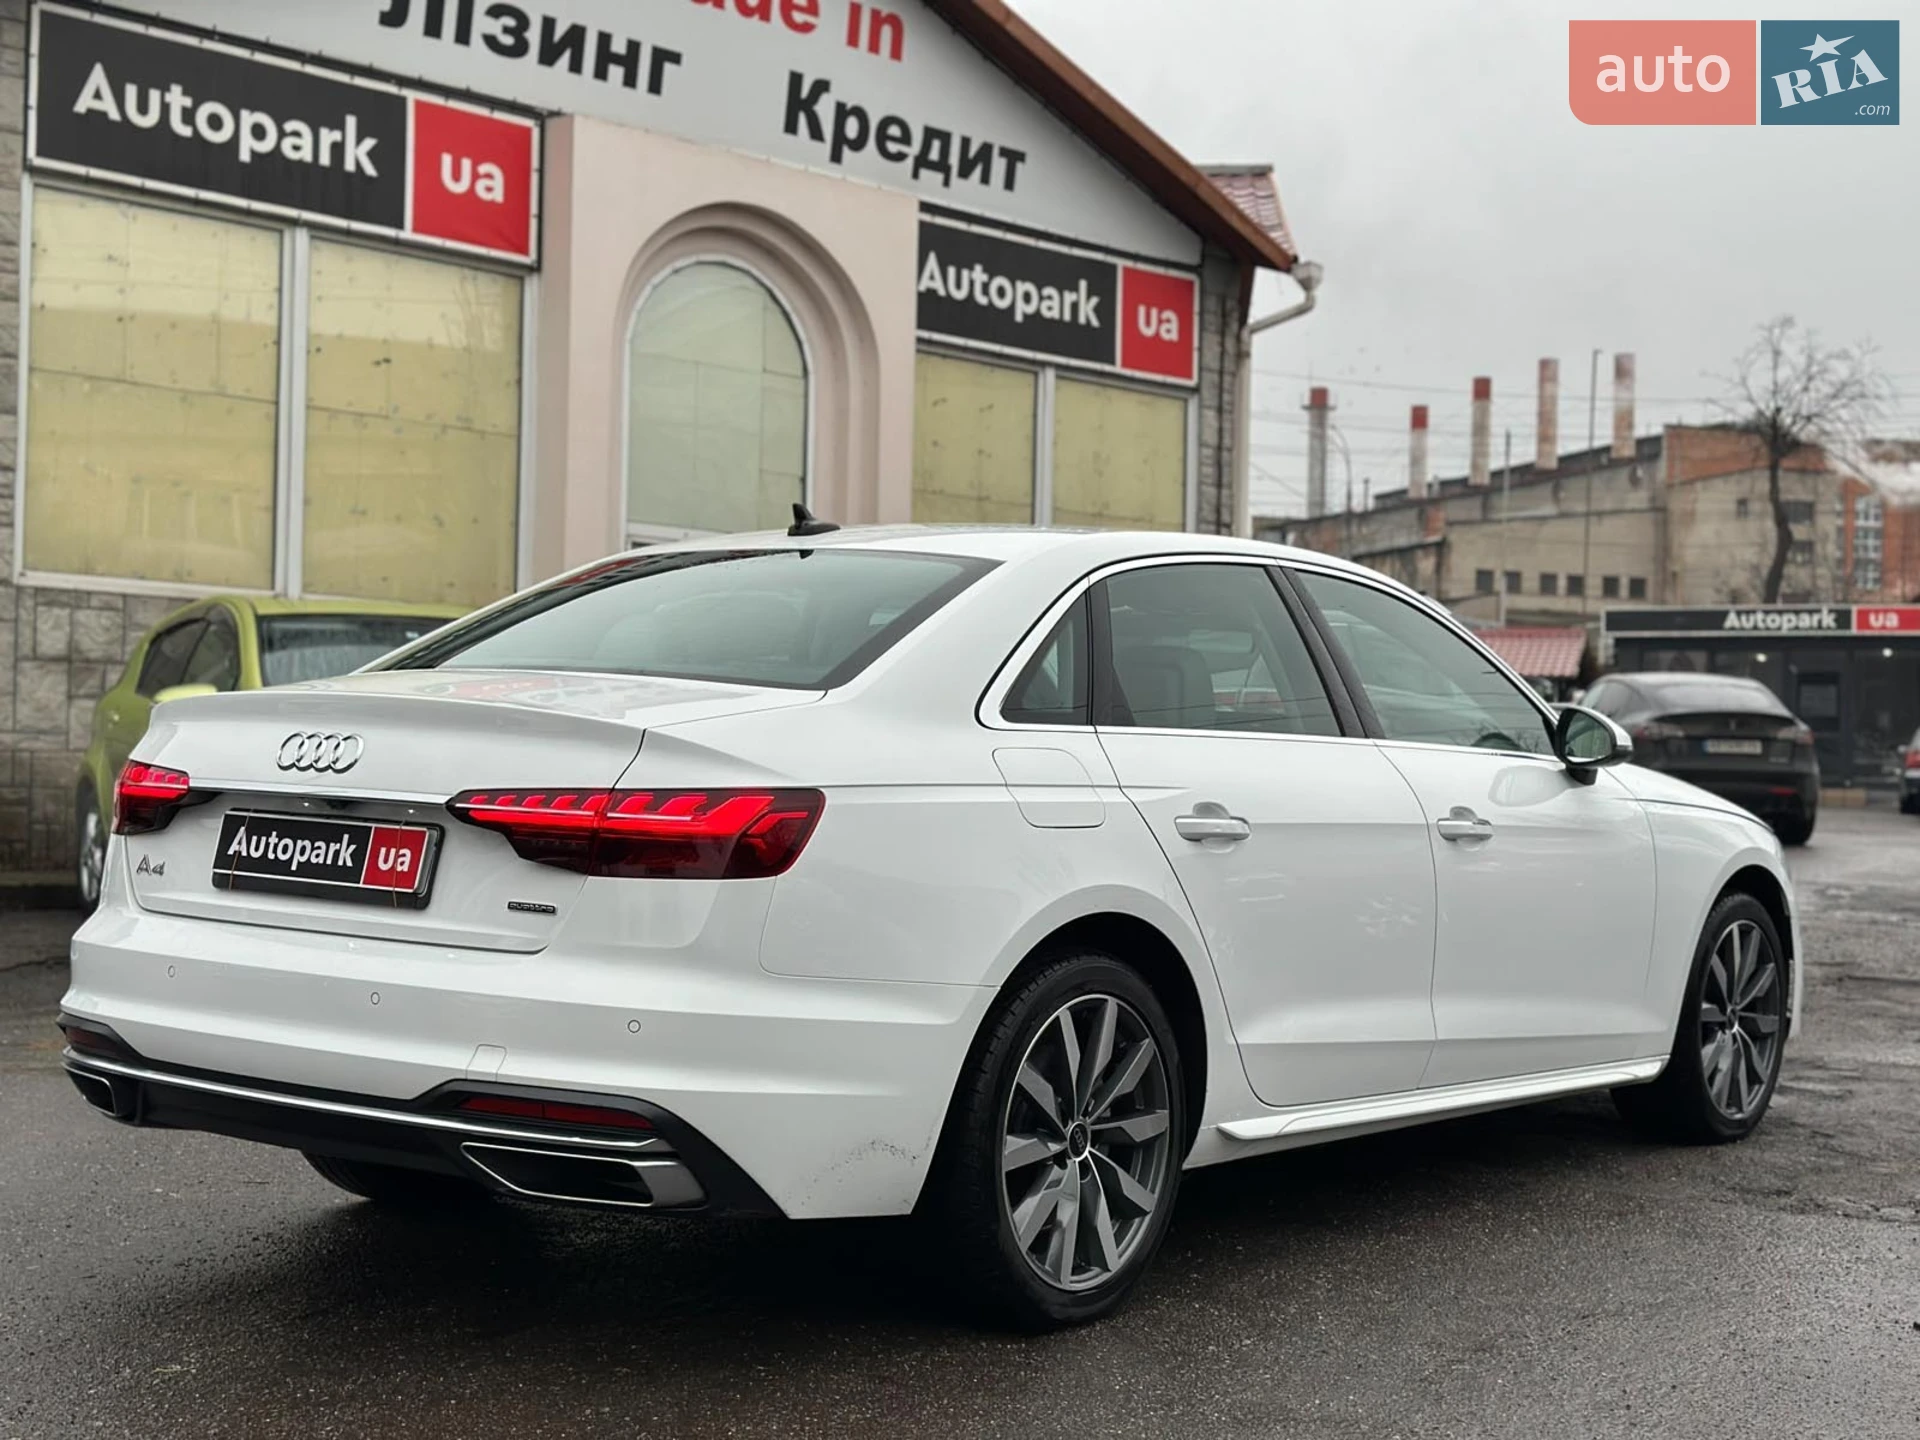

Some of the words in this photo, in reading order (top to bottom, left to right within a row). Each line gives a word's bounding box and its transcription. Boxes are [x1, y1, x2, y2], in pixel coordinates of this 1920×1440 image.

[846, 1, 904, 62] in
[73, 62, 378, 177] Autopark
[440, 152, 505, 203] ua
[783, 70, 1026, 192] Кредит
[918, 251, 1100, 328] Autopark
[1137, 303, 1180, 343] ua
[1723, 607, 1838, 633] Autopark
[1869, 611, 1899, 628] ua
[136, 854, 165, 876] A4
[228, 826, 356, 870] Autopark
[377, 846, 412, 873] ua
[508, 902, 555, 913] quattro
